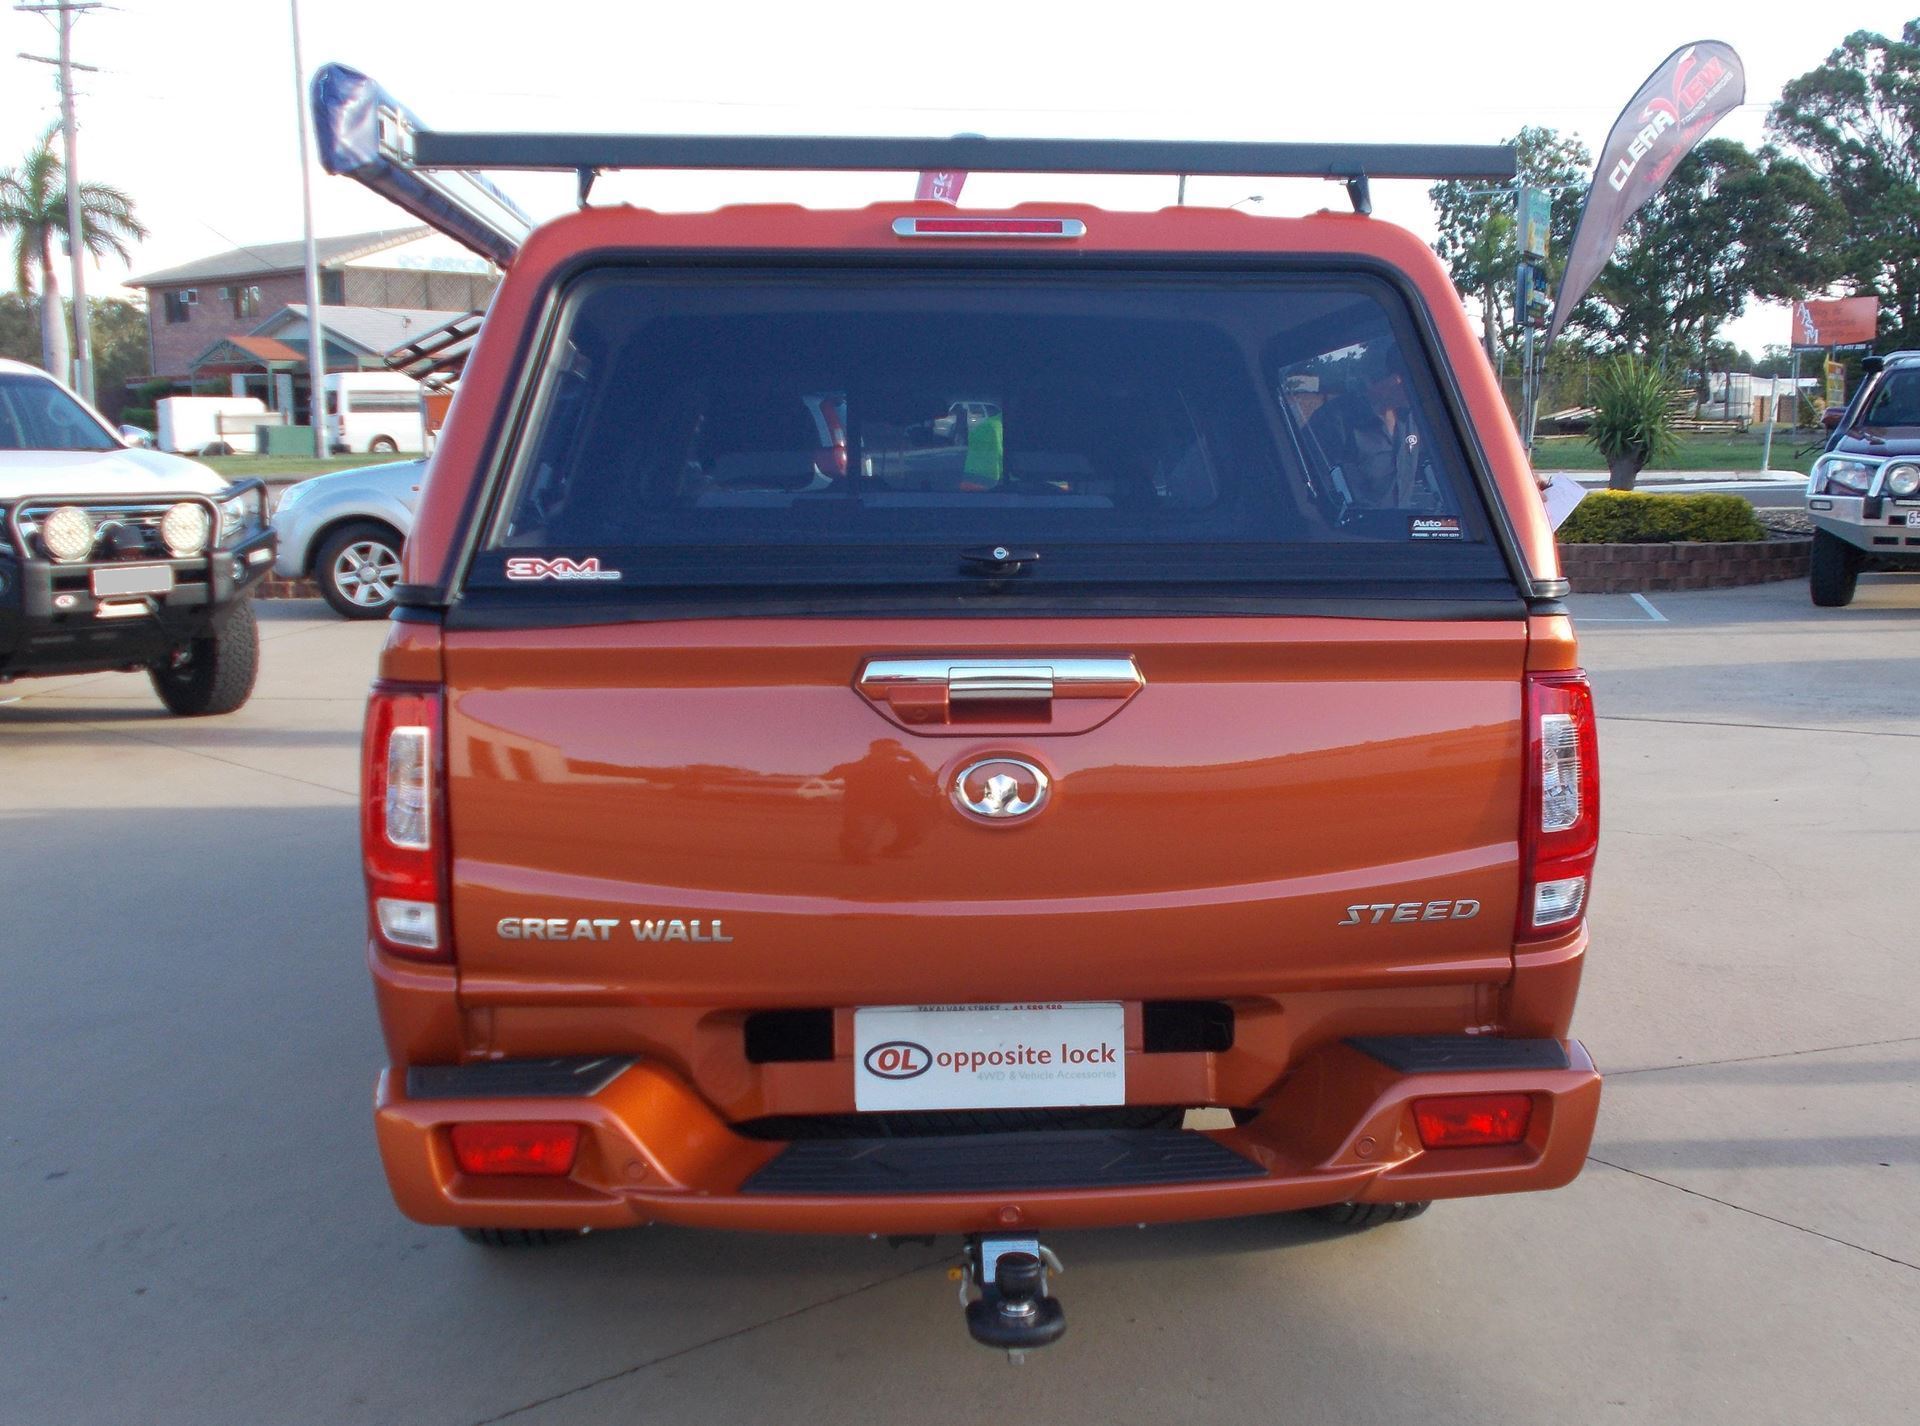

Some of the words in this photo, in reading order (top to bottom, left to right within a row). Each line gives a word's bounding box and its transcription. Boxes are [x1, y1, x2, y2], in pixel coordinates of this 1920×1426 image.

[933, 171, 948, 199] ck
[507, 558, 599, 580] 3XM
[1337, 899, 1481, 927] STEED
[496, 917, 620, 942] GREAT
[629, 918, 734, 943] WALL
[877, 1048, 918, 1072] OL
[936, 1044, 1052, 1073] opposite
[1061, 1042, 1116, 1064] lock
[976, 1071, 1005, 1081] 4WD
[1018, 1070, 1054, 1080] Vehicle
[1057, 1069, 1117, 1080] Accessories
